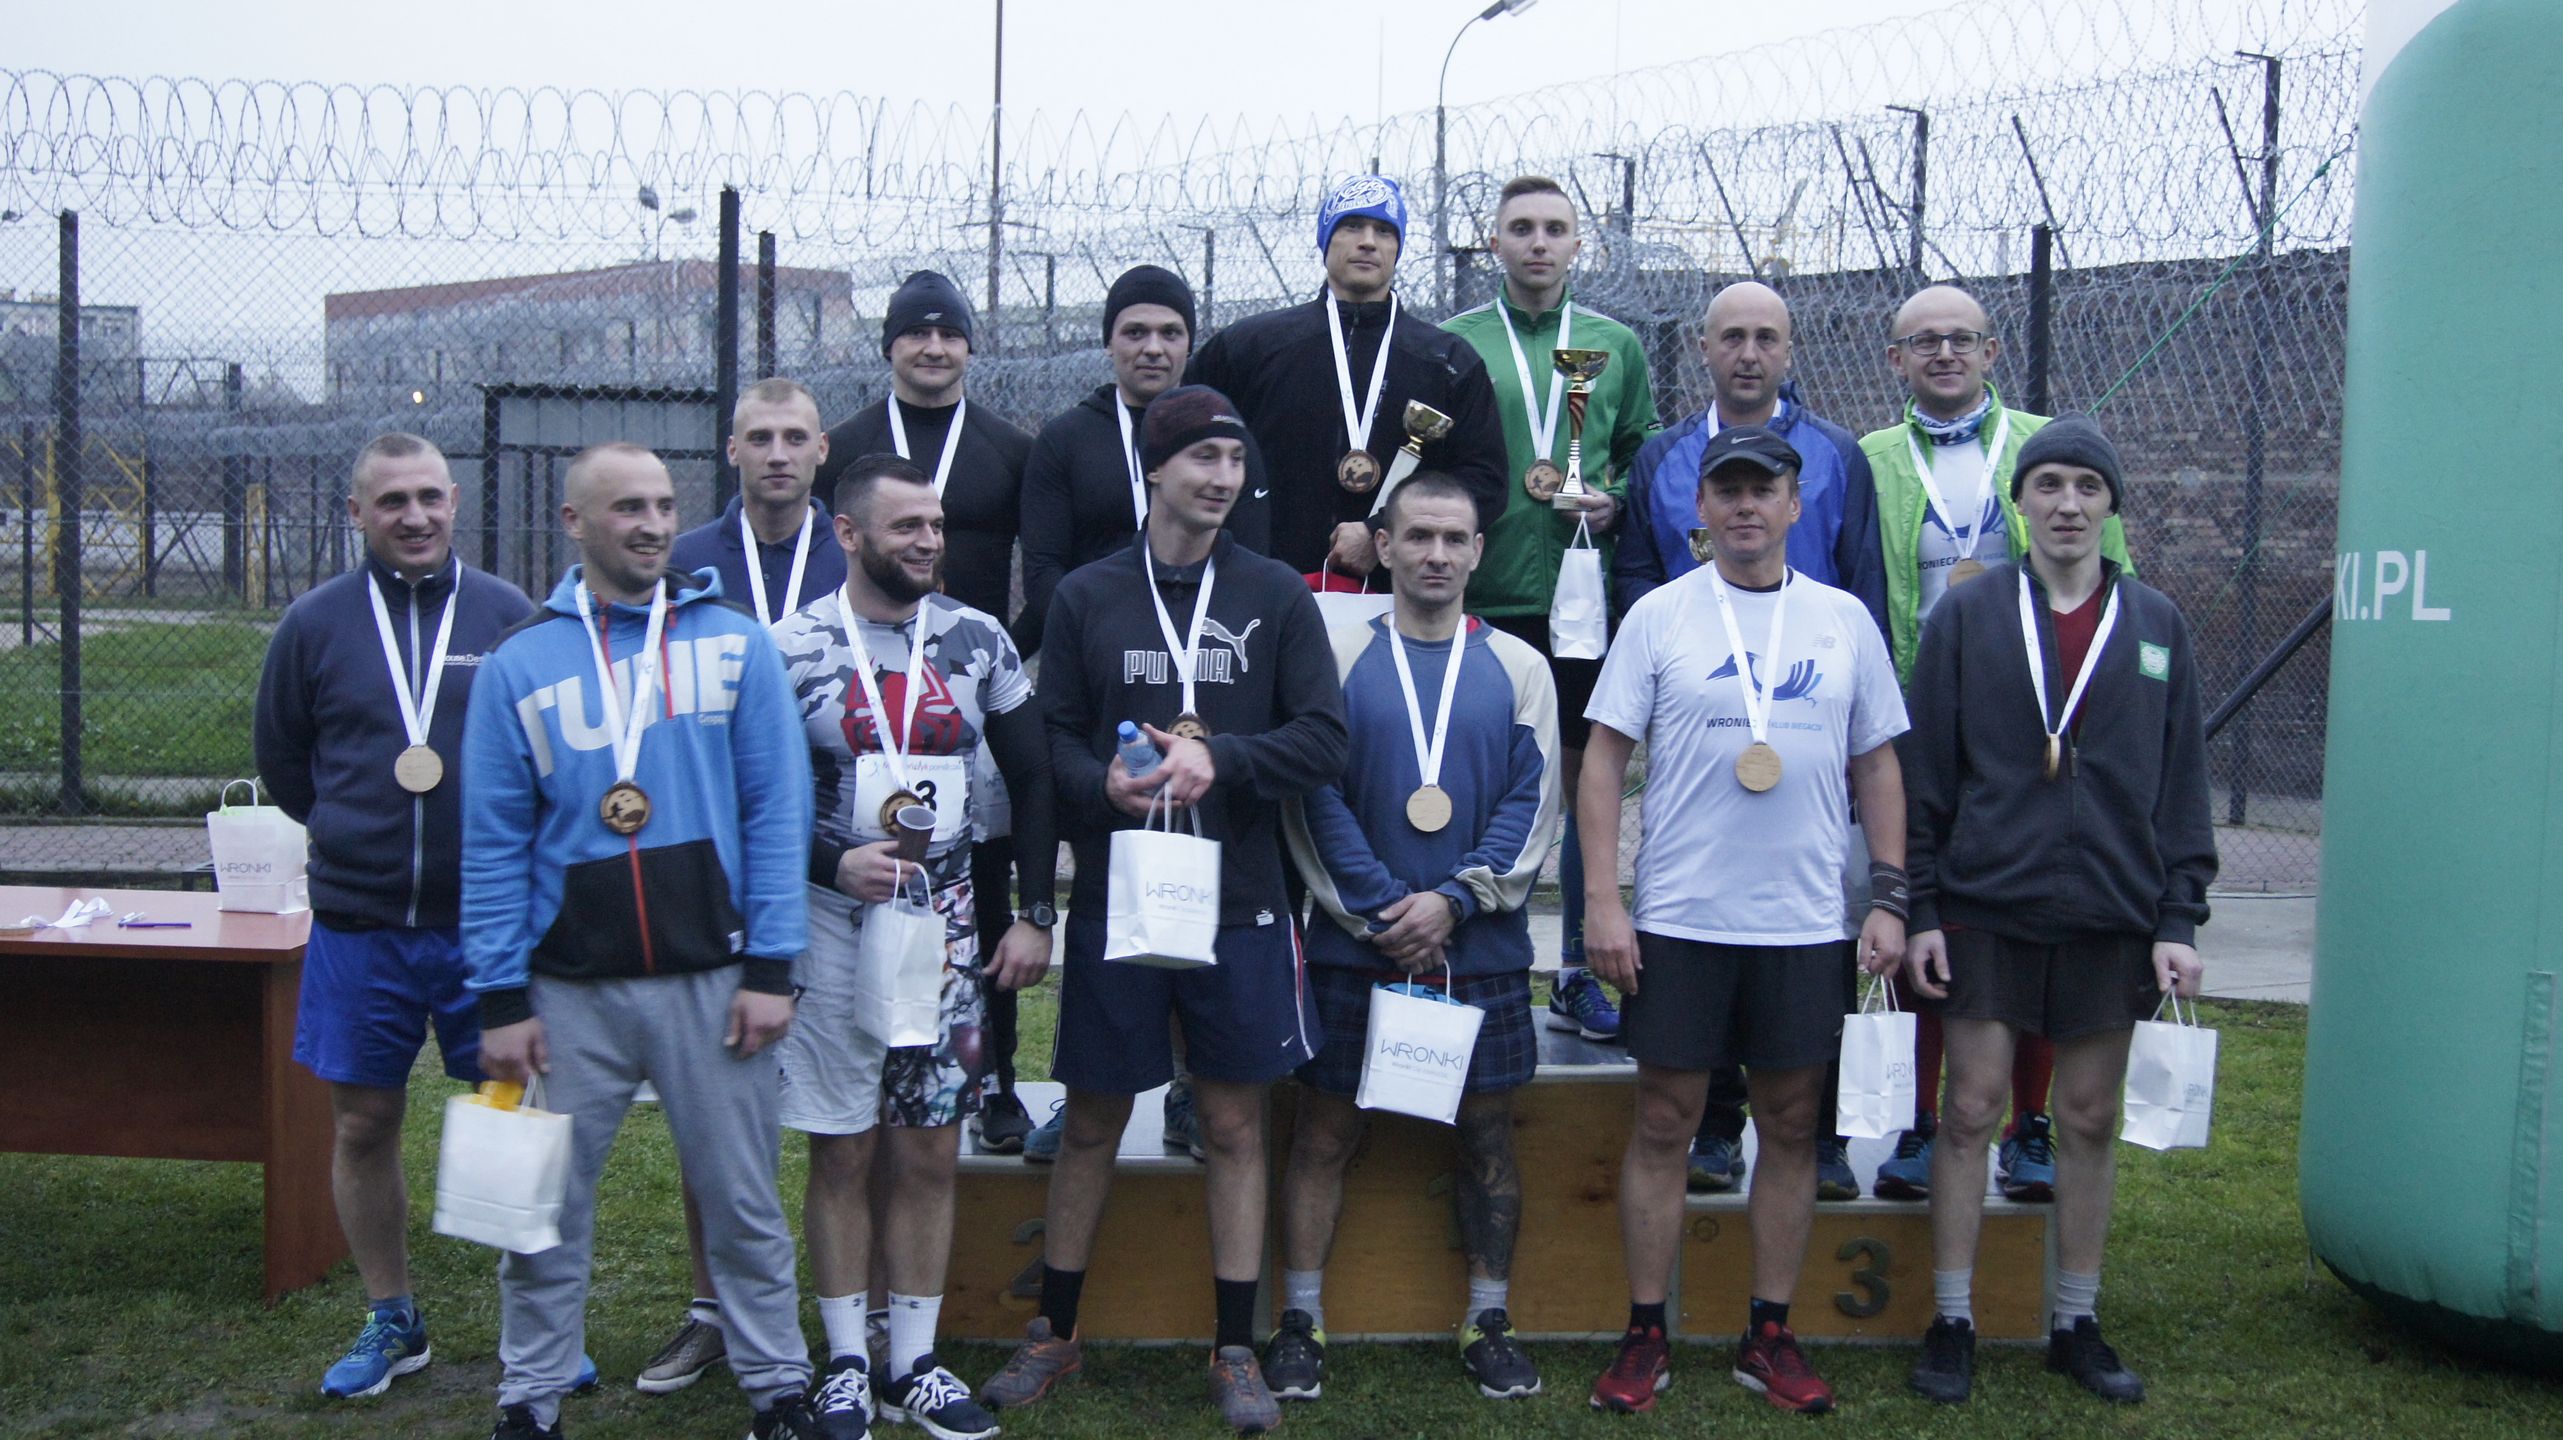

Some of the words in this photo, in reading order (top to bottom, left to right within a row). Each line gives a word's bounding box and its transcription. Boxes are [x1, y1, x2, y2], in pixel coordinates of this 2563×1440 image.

[2335, 549, 2452, 621] KI.PL
[220, 862, 272, 873] WRONKI
[1380, 1039, 1464, 1071] WRONKI
[1835, 1236, 1890, 1317] 3
